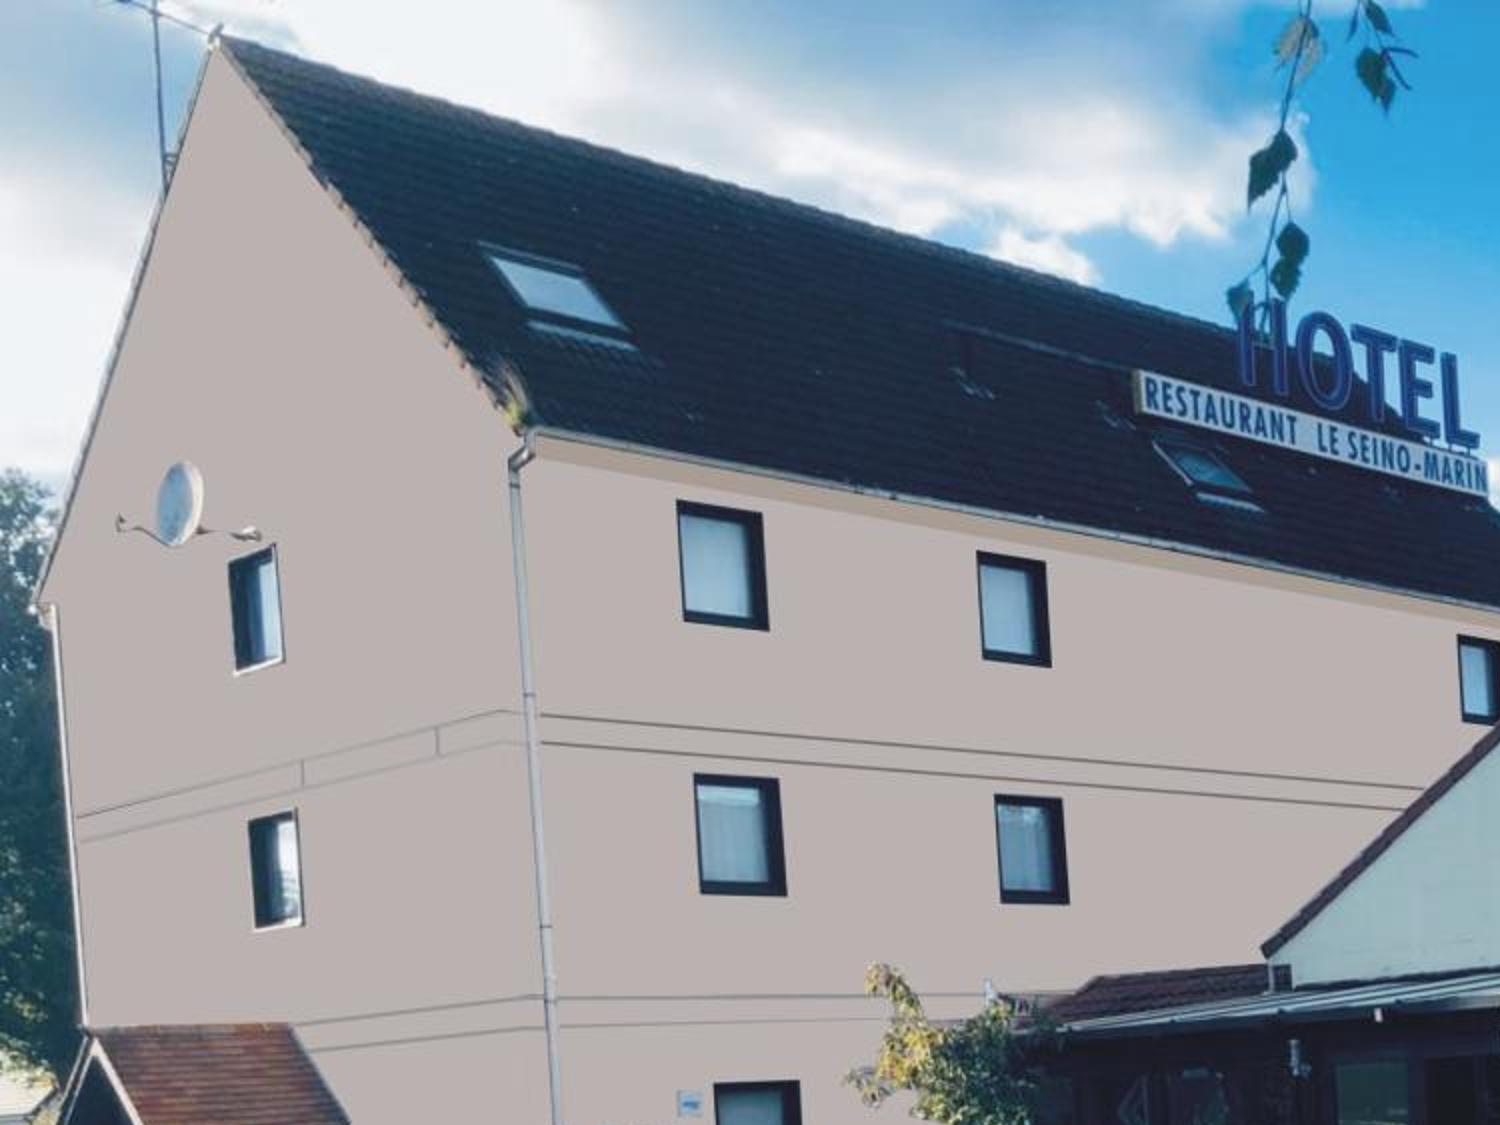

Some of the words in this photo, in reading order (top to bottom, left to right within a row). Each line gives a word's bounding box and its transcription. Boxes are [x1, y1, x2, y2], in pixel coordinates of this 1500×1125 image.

[1144, 376, 1299, 446] RESTAURANT
[1317, 422, 1341, 456] LE
[1347, 433, 1488, 493] SEINO-MARIN
[1236, 295, 1481, 449] HOTEL
